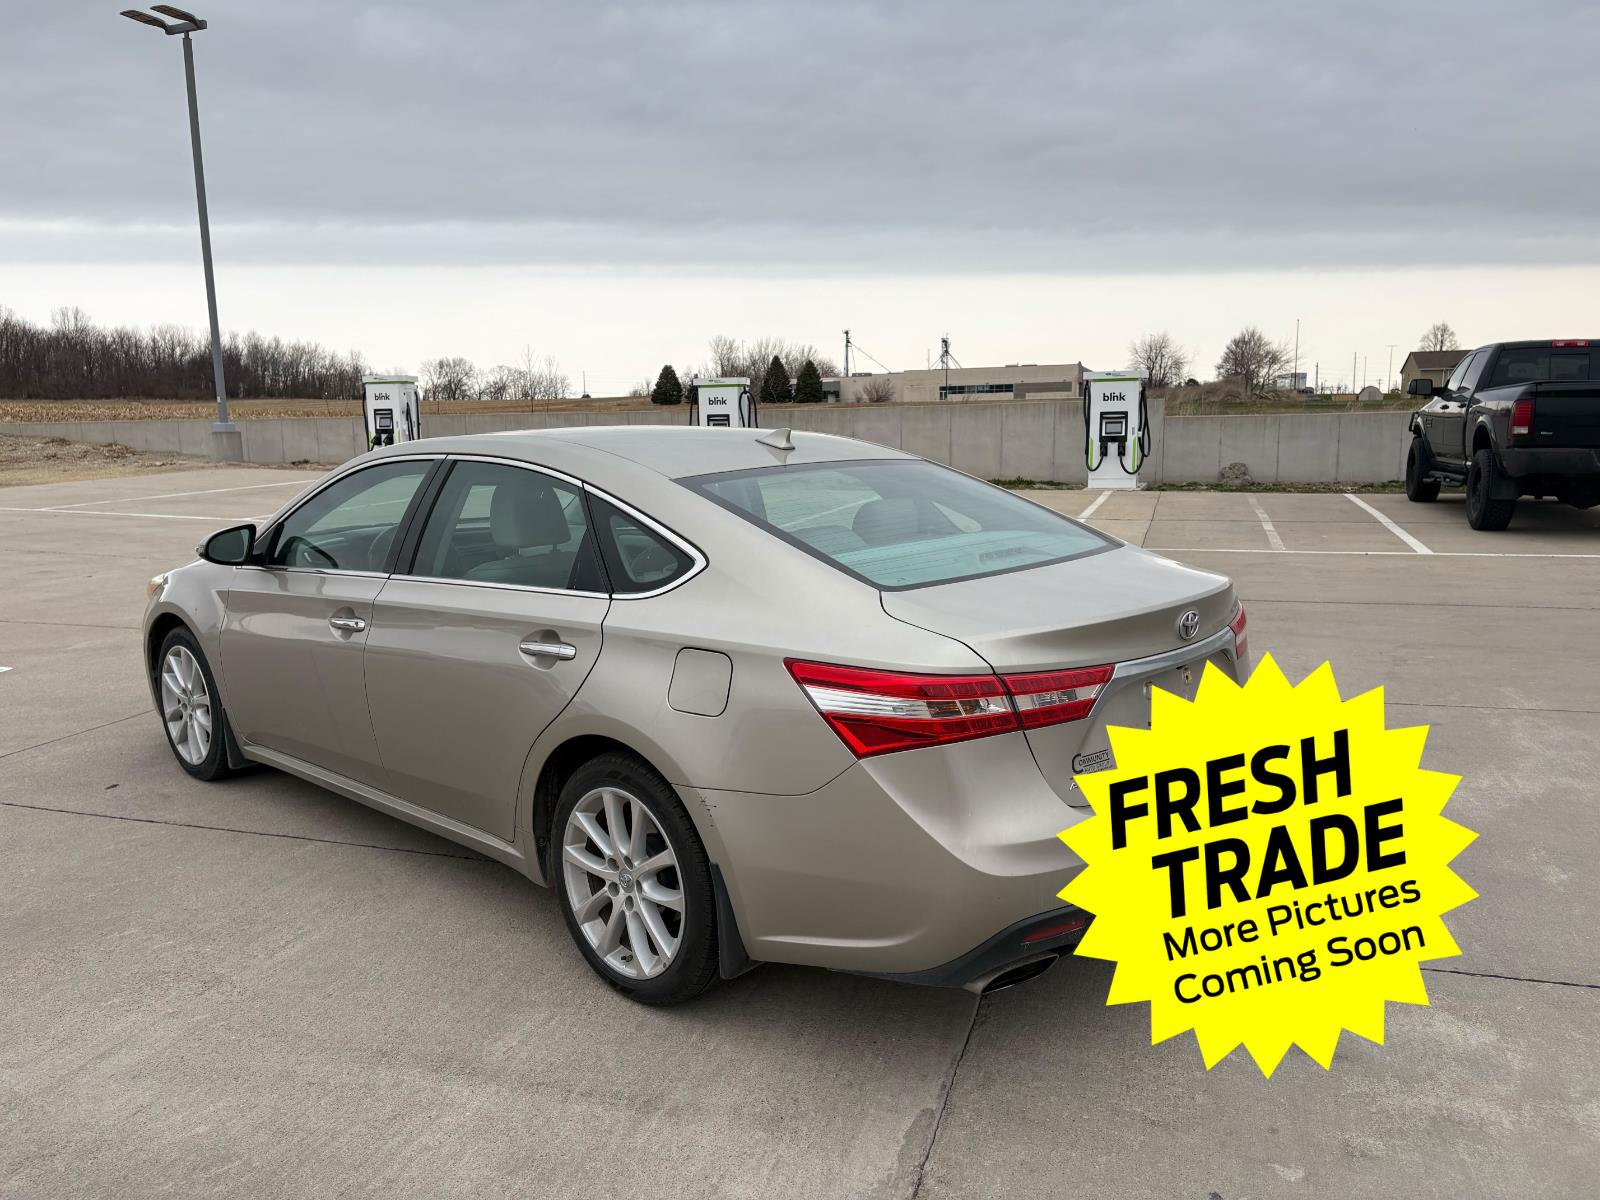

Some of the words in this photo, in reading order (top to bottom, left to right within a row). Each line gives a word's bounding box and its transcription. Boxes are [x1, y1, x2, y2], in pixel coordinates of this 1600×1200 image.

[374, 393, 391, 401] blink
[708, 396, 727, 406] blink
[1102, 391, 1126, 402] blink
[1072, 751, 1110, 774] COMMUNITY
